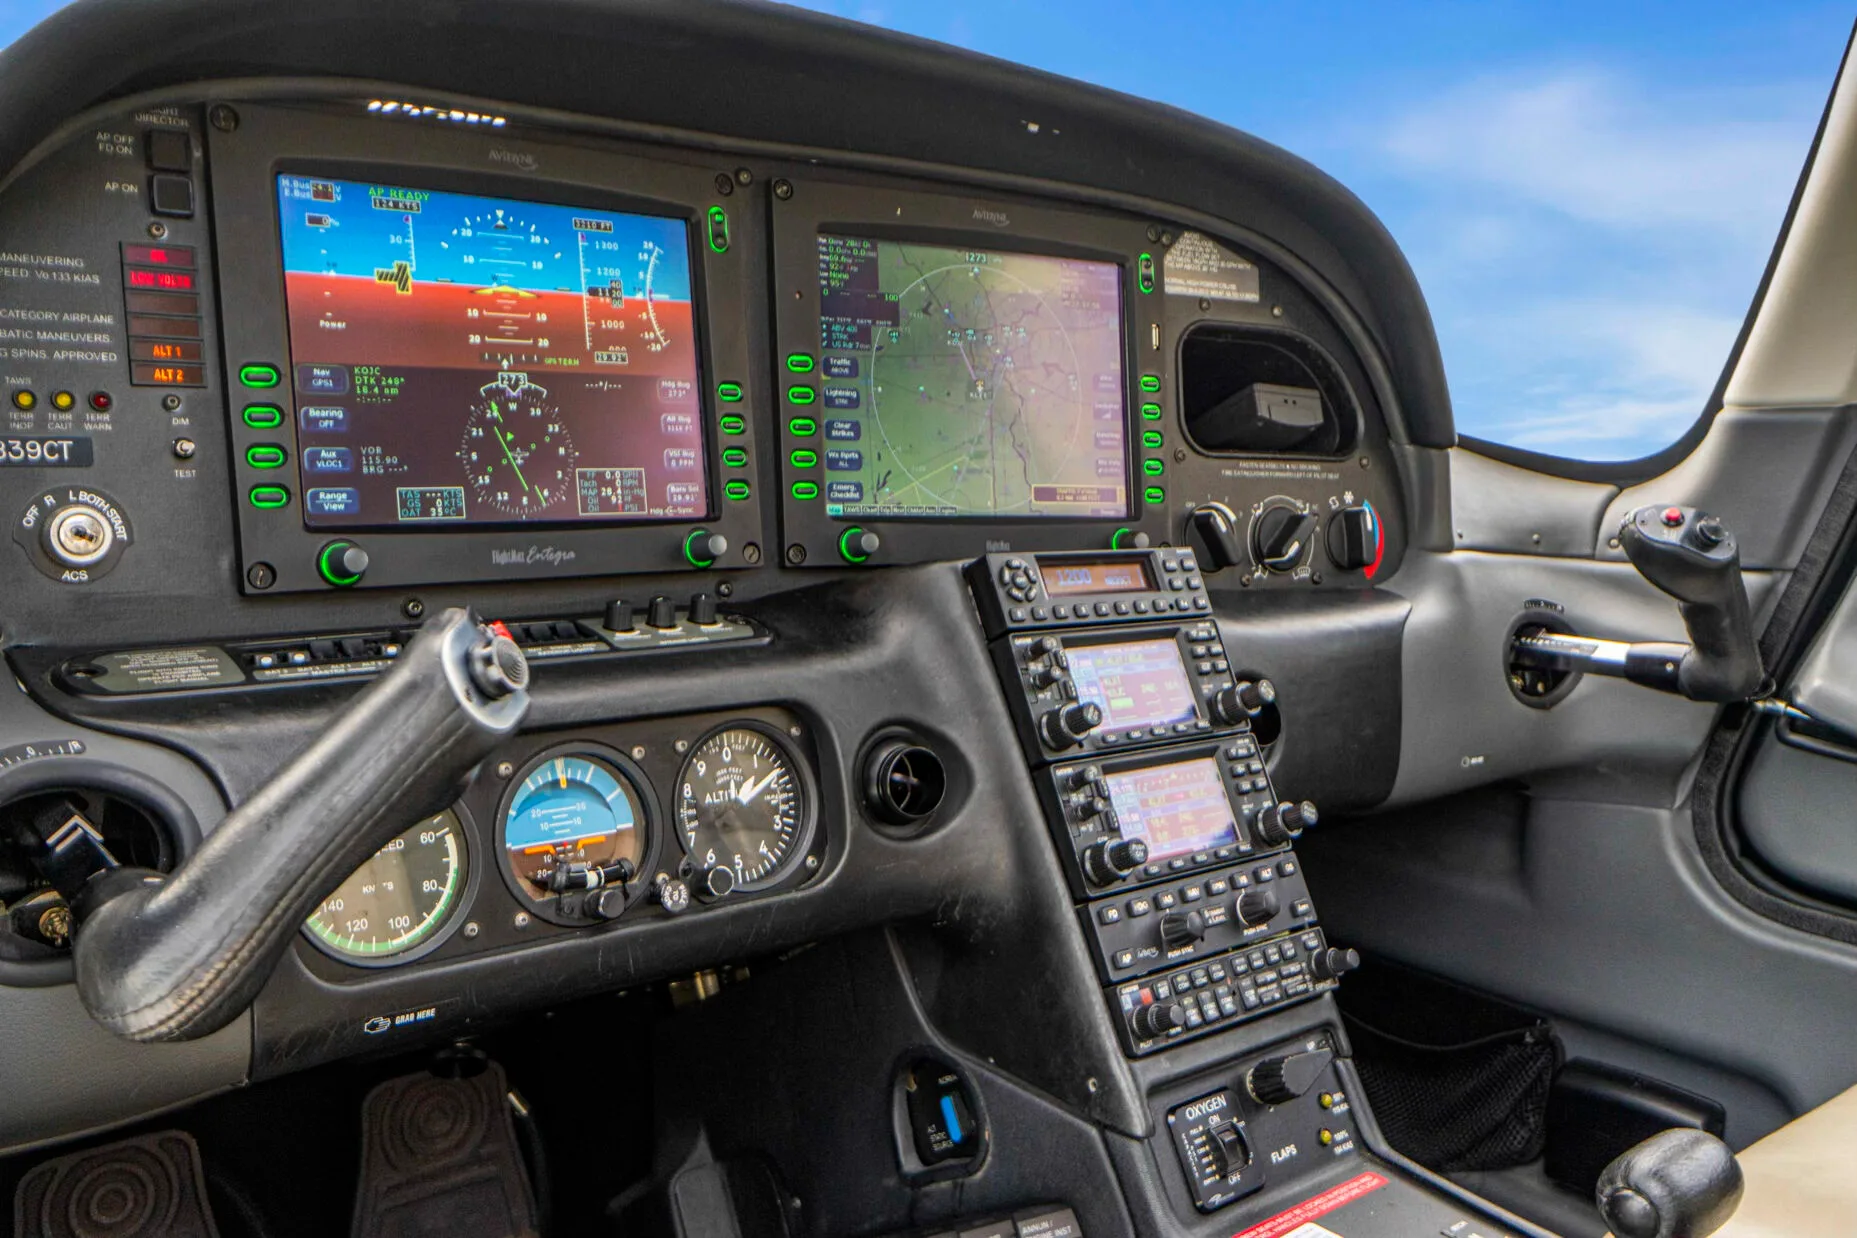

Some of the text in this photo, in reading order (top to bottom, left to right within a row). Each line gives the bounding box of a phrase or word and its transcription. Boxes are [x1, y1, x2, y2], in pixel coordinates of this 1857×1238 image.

[105, 182, 139, 193] AP ON
[369, 187, 430, 201] AP READY
[52, 271, 71, 282] 133
[74, 274, 100, 285] KIAS
[0, 308, 115, 324] CATEGORY AIRPLANE
[53, 351, 118, 362] APPROVED
[153, 345, 173, 358] ALT
[5, 376, 32, 385] TAWS
[154, 368, 184, 383] ALT 2
[355, 376, 377, 385] DTK
[501, 374, 525, 386] 273
[508, 402, 517, 411] W
[309, 408, 343, 419] Bearing
[172, 417, 190, 426] DIM
[320, 450, 337, 458] Aux
[360, 446, 382, 455] VOR
[174, 469, 196, 478] TEST
[319, 491, 347, 501] Range
[323, 502, 345, 511] View
[23, 490, 128, 541] OFF R L BOTH START
[61, 570, 89, 582] ACS
[1056, 568, 1092, 586] 1200
[722, 746, 731, 763] 0
[697, 761, 706, 777] 9
[683, 783, 692, 798] 8
[531, 809, 542, 818] 20
[540, 817, 582, 831] 10 10
[773, 814, 782, 830] 3
[420, 831, 436, 845] 60
[688, 831, 696, 847] 7
[759, 840, 769, 854] 4
[543, 854, 552, 863] 10
[706, 848, 716, 864] 6
[734, 854, 743, 870] 5
[537, 870, 547, 878] 20
[423, 880, 438, 892] 80
[321, 899, 344, 912] 140
[346, 919, 368, 932] 120
[388, 915, 410, 930] 100
[395, 1008, 436, 1024] GRAB HERE
[1185, 1094, 1227, 1120] OXYGEN
[1208, 1113, 1221, 1125] ON
[1270, 1143, 1298, 1165] FLAPS
[1228, 1172, 1241, 1185] OFF
